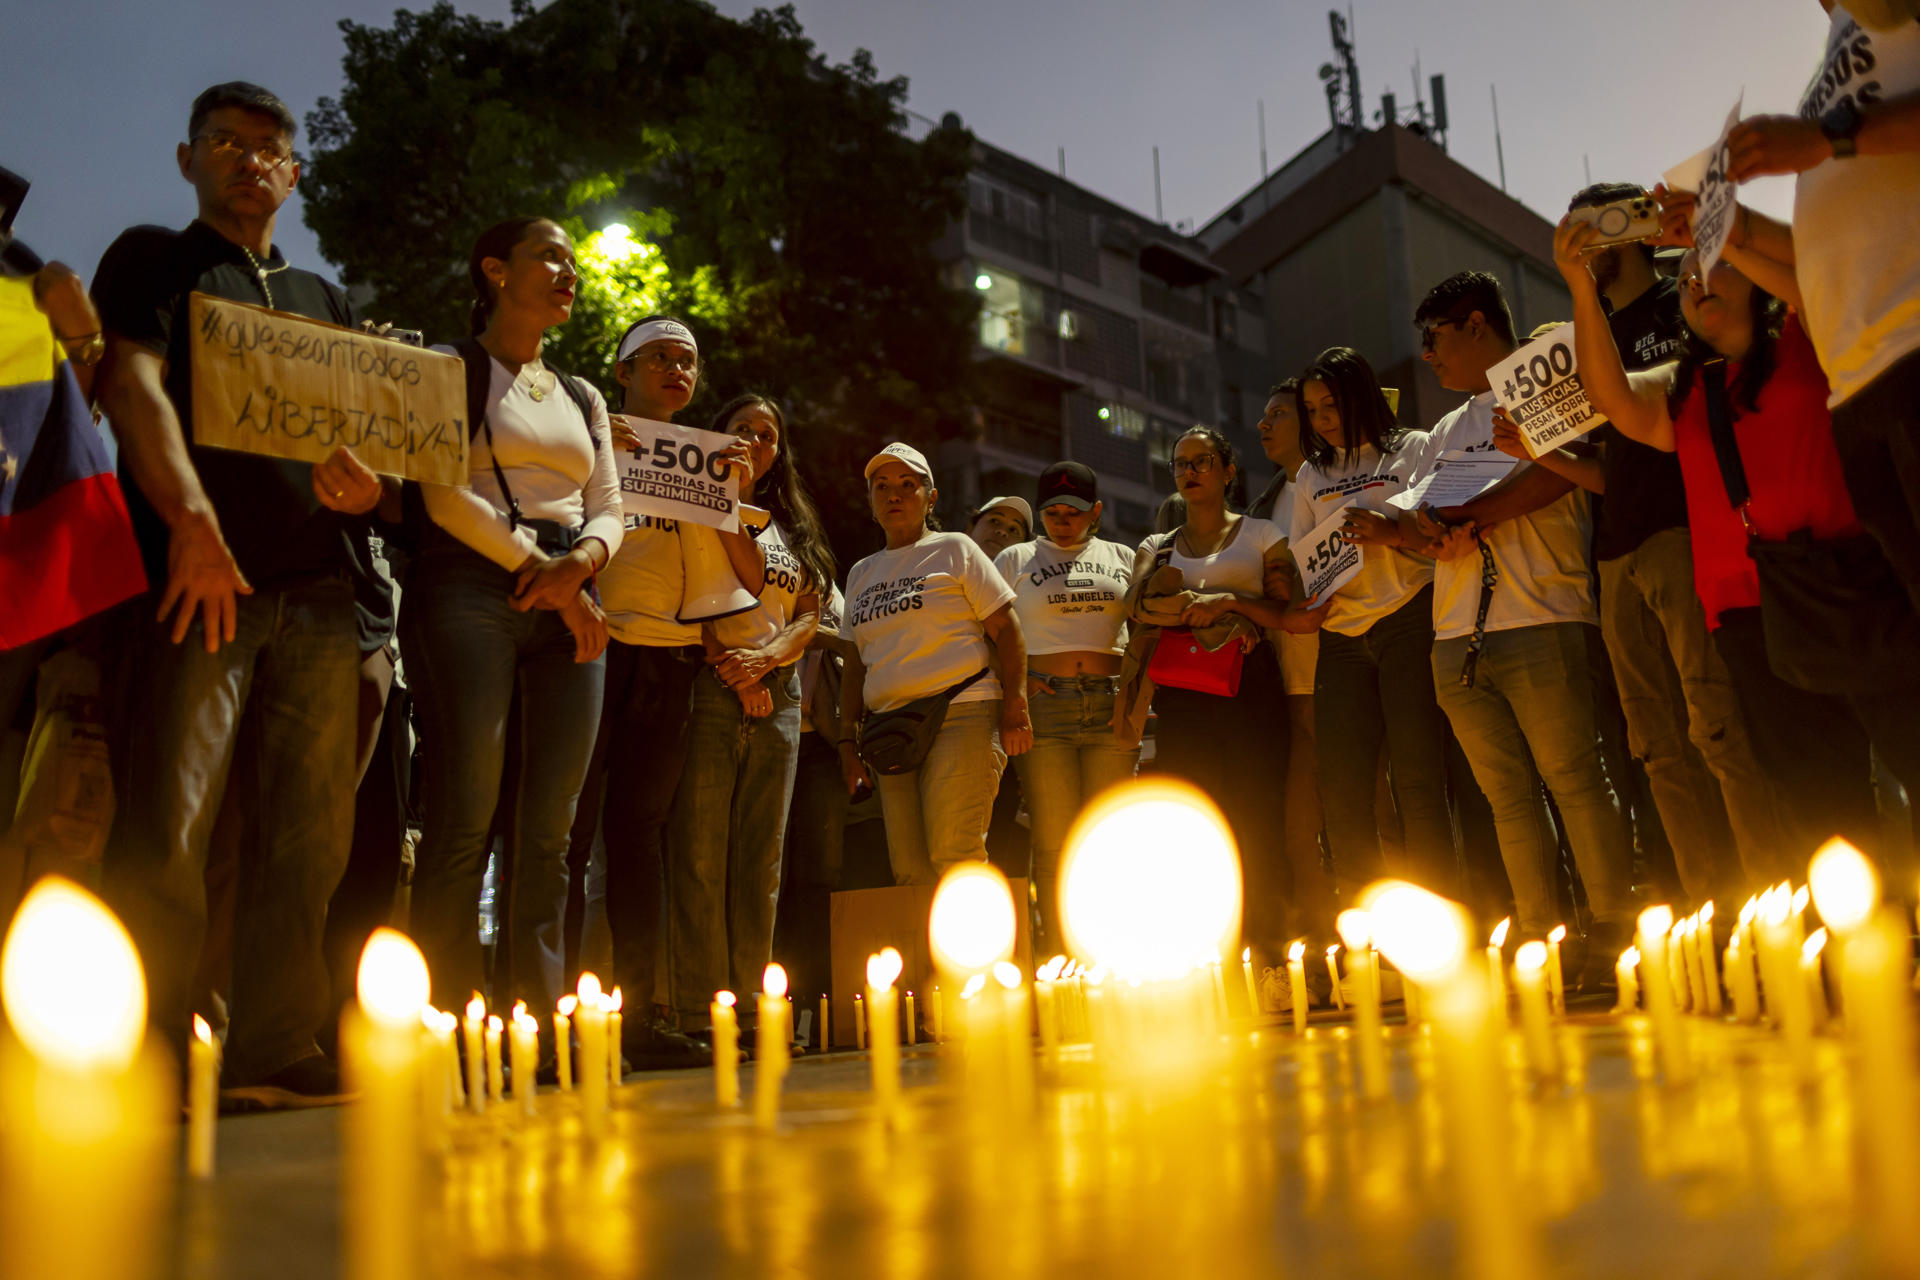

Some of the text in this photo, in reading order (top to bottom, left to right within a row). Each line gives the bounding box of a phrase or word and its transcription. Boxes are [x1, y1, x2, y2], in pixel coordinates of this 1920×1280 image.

[1634, 332, 1656, 353] BIG
[1502, 343, 1573, 401] +500
[1519, 376, 1580, 421] AUSENCIAS
[1524, 391, 1590, 433] PESAN SOBRE
[1530, 405, 1597, 447] VENEZUELA
[627, 438, 731, 482] +500
[623, 479, 729, 511] SUFRIMIENTO
[628, 467, 727, 498] HISTORIAS DE
[1312, 474, 1400, 501] VENEZOLANA
[1030, 561, 1121, 587] CALIFORNIA
[1047, 592, 1115, 604] LOS ANGELES
